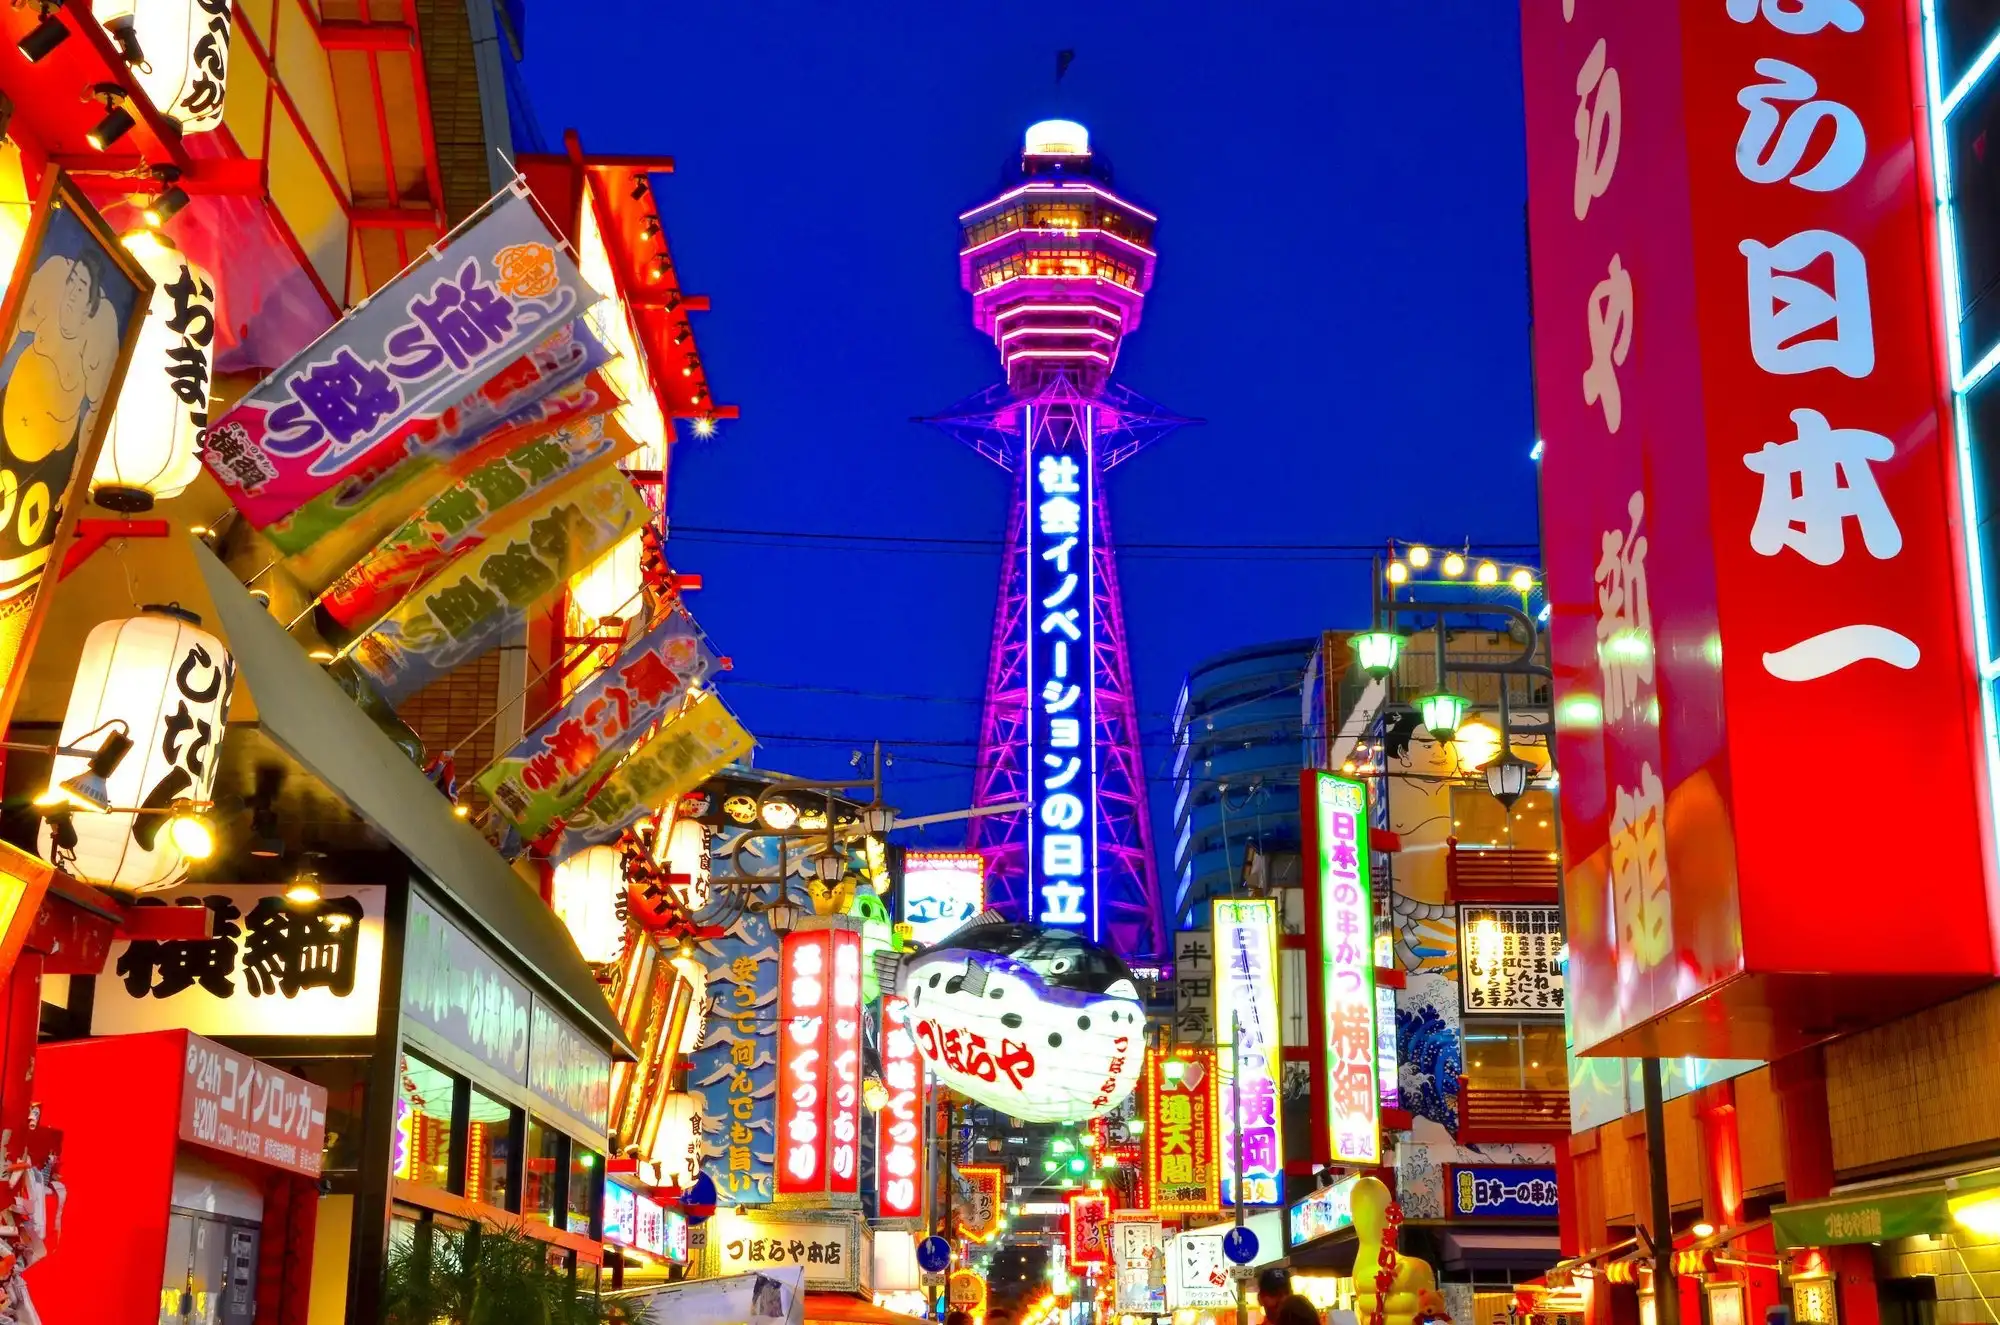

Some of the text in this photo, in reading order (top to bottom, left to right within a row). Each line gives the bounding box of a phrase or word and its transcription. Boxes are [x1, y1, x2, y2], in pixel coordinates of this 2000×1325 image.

[262, 258, 516, 455] 造り盛り
[1564, 0, 1673, 984] らや新館
[1038, 455, 1087, 925] 社会イノベーションの日立
[115, 894, 365, 999] 横綱
[1331, 811, 1362, 992] 日本一の串かつ
[1177, 940, 1213, 1034] 半田屋
[1469, 957, 1485, 1007] もち
[1501, 958, 1519, 1007] 紅しょうが
[1517, 959, 1534, 1007] にんにく
[1533, 958, 1549, 1007] 玉ねぎ
[196, 1049, 325, 1140] 24h コインロッカー
[916, 1018, 1035, 1091] づぼらや
[1330, 1002, 1374, 1126] 横綱
[193, 1097, 218, 1143] ¥200
[217, 1122, 261, 1156] COIN-LOCKER
[1160, 1094, 1193, 1184] 通天閣
[1194, 1095, 1206, 1183] TSUTENKAKU
